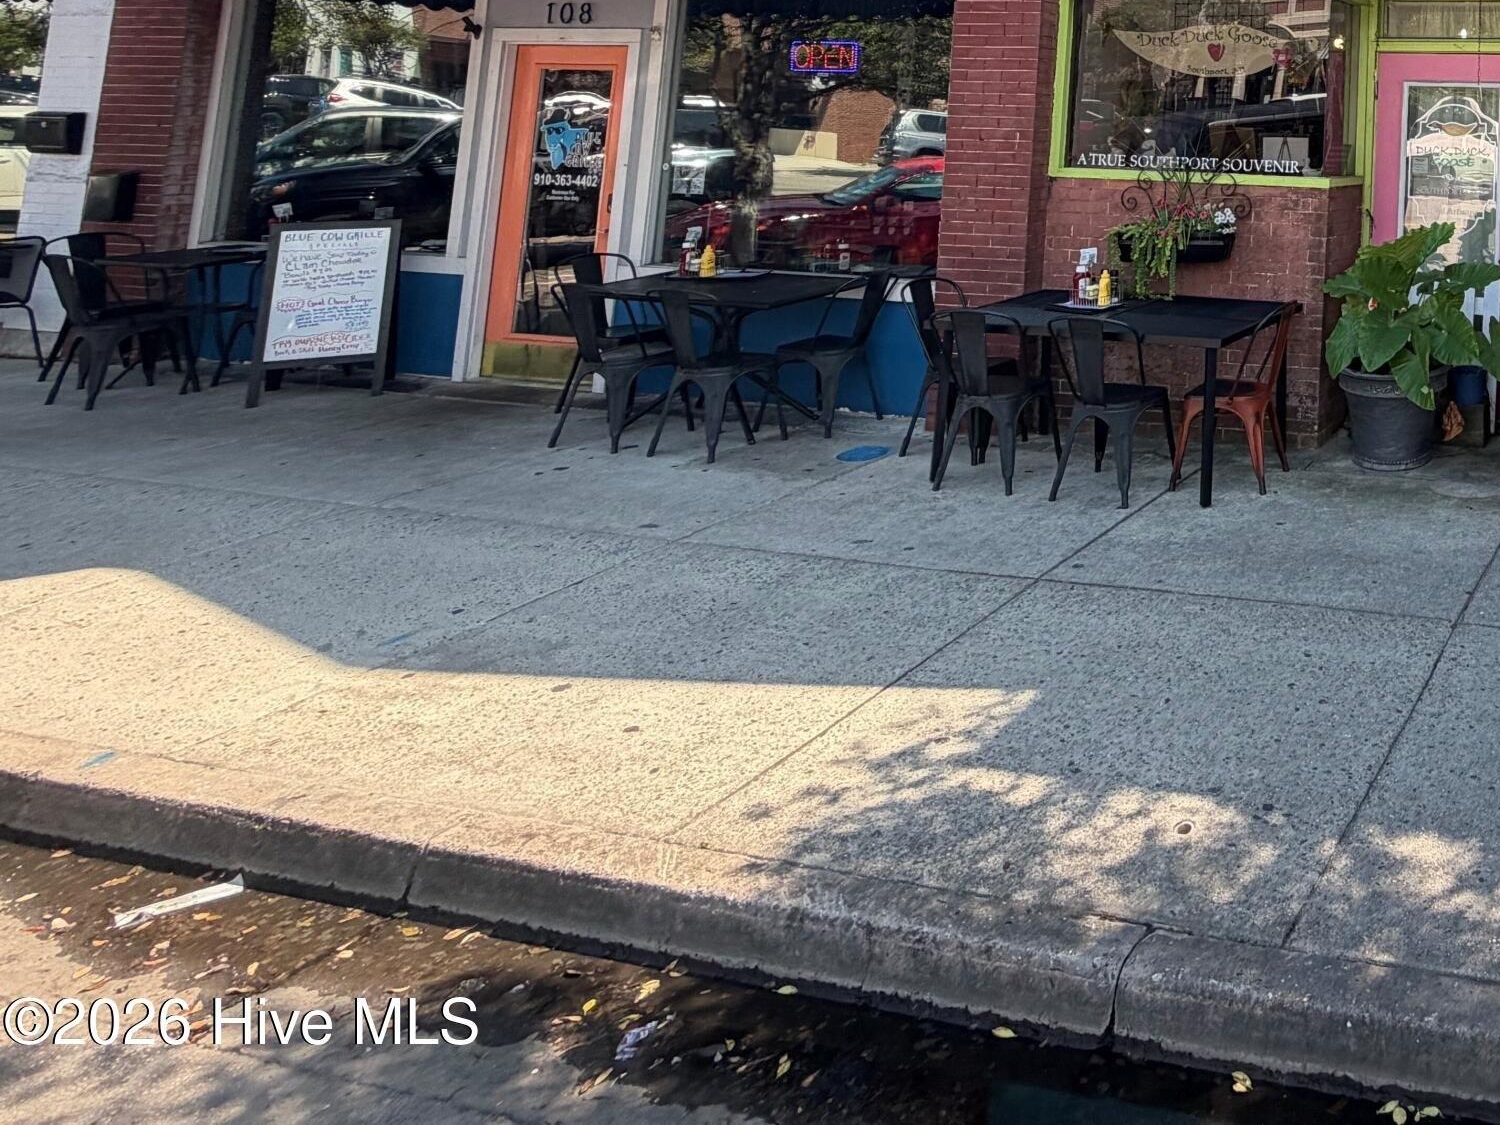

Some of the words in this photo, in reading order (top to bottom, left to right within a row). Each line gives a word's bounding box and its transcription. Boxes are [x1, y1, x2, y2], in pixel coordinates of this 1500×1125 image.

[547, 2, 592, 24] 108
[1136, 32, 1180, 47] Duck
[1181, 27, 1224, 43] Duck
[1228, 27, 1278, 48] Goose
[795, 44, 855, 69] OPEN
[1077, 155, 1087, 165] A
[1089, 153, 1126, 167] TRUE
[1130, 155, 1219, 171] SOUTHPORT
[1222, 157, 1300, 173] SOUVENIR
[534, 174, 598, 187] 910-363-4402
[285, 233, 315, 242] BLUE
[320, 232, 343, 242] COW
[346, 230, 384, 241] GRILLE
